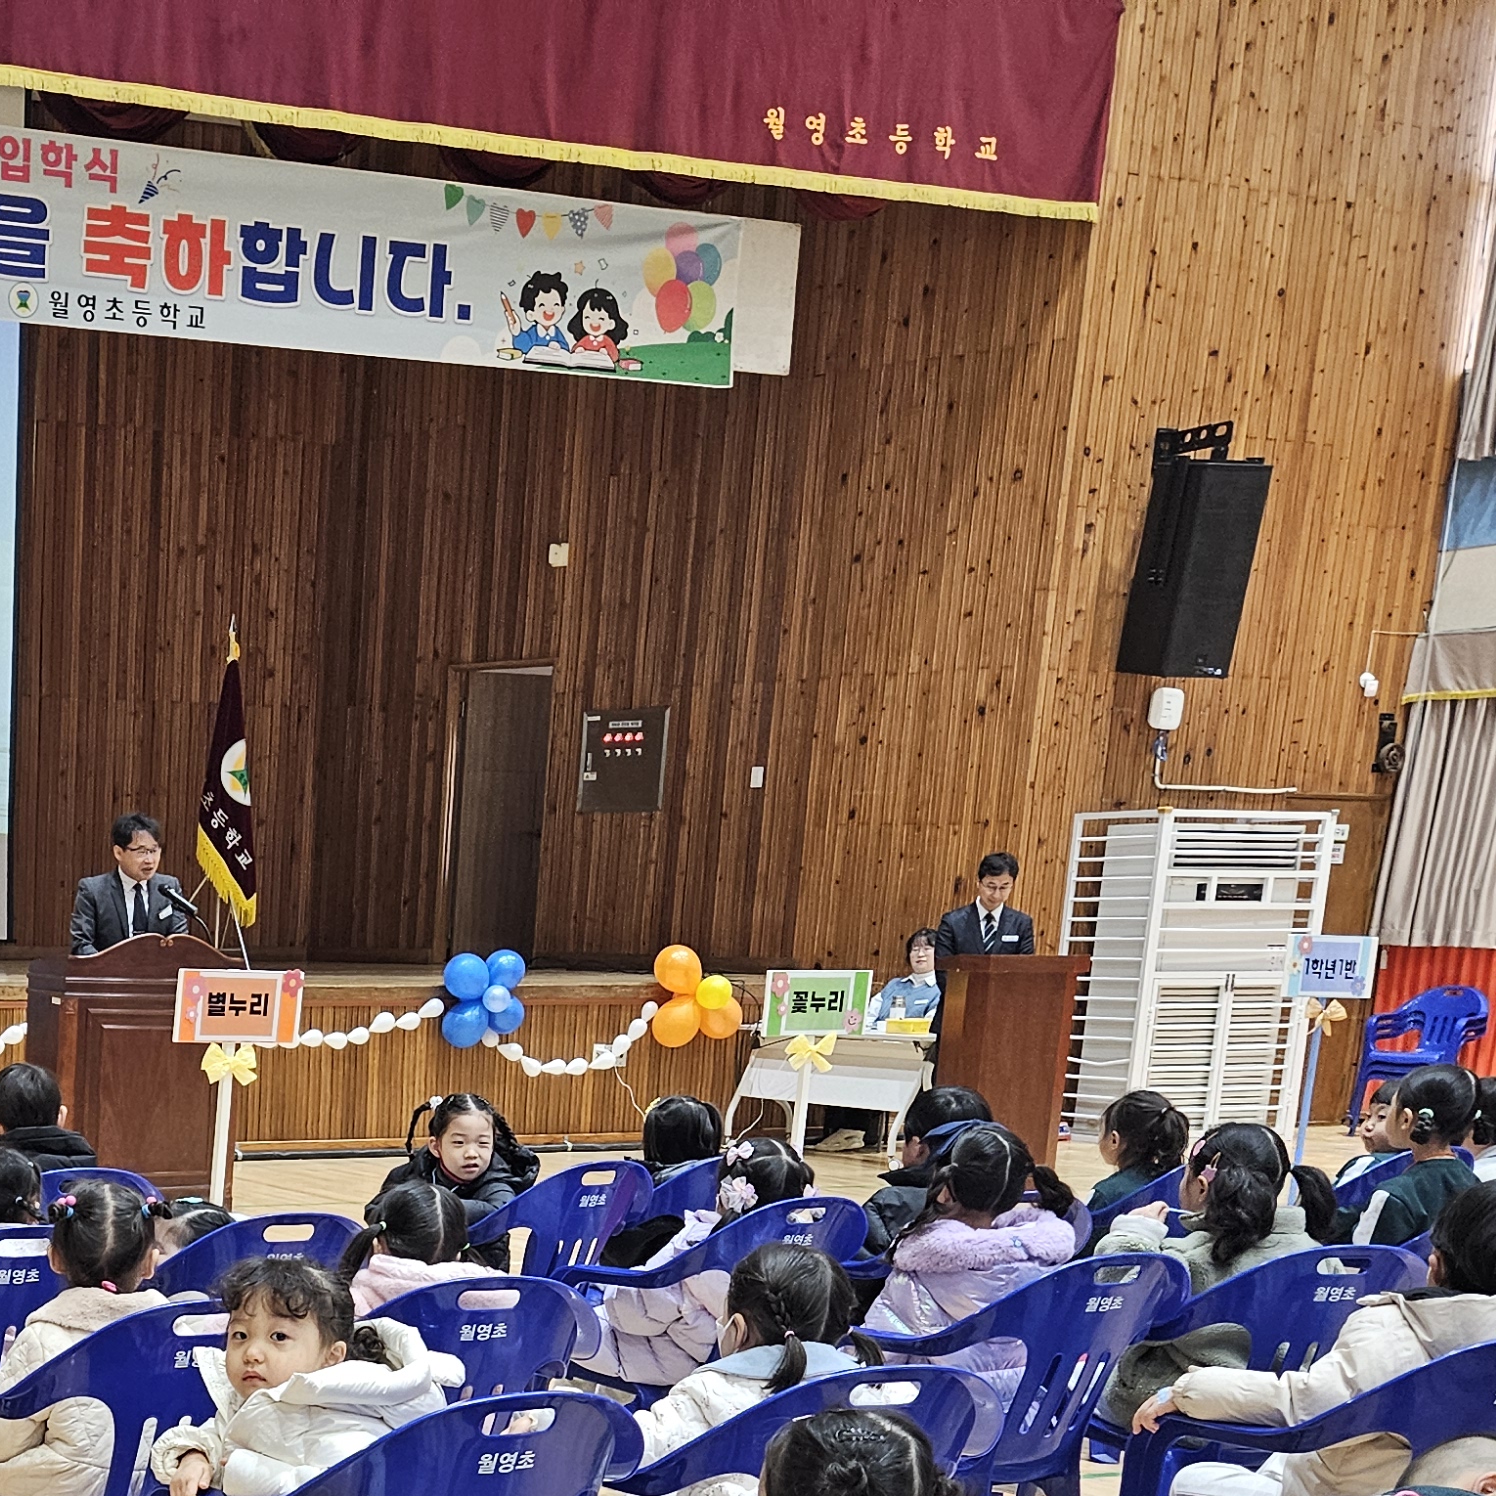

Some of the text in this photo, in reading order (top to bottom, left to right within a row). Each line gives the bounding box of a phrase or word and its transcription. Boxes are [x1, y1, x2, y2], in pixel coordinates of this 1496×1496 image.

[763, 106, 998, 161] 월영초등학교
[83, 204, 471, 321] 축하합니다.
[48, 289, 206, 331] 월영초등학교
[207, 992, 269, 1017] 별누리
[791, 990, 845, 1014] 꽃누리
[578, 1193, 607, 1208] 월영초
[1085, 1296, 1124, 1313] 월영초
[1313, 1286, 1357, 1303] 월영초
[459, 1322, 507, 1342] 월영초
[477, 1450, 536, 1475] 월영초
